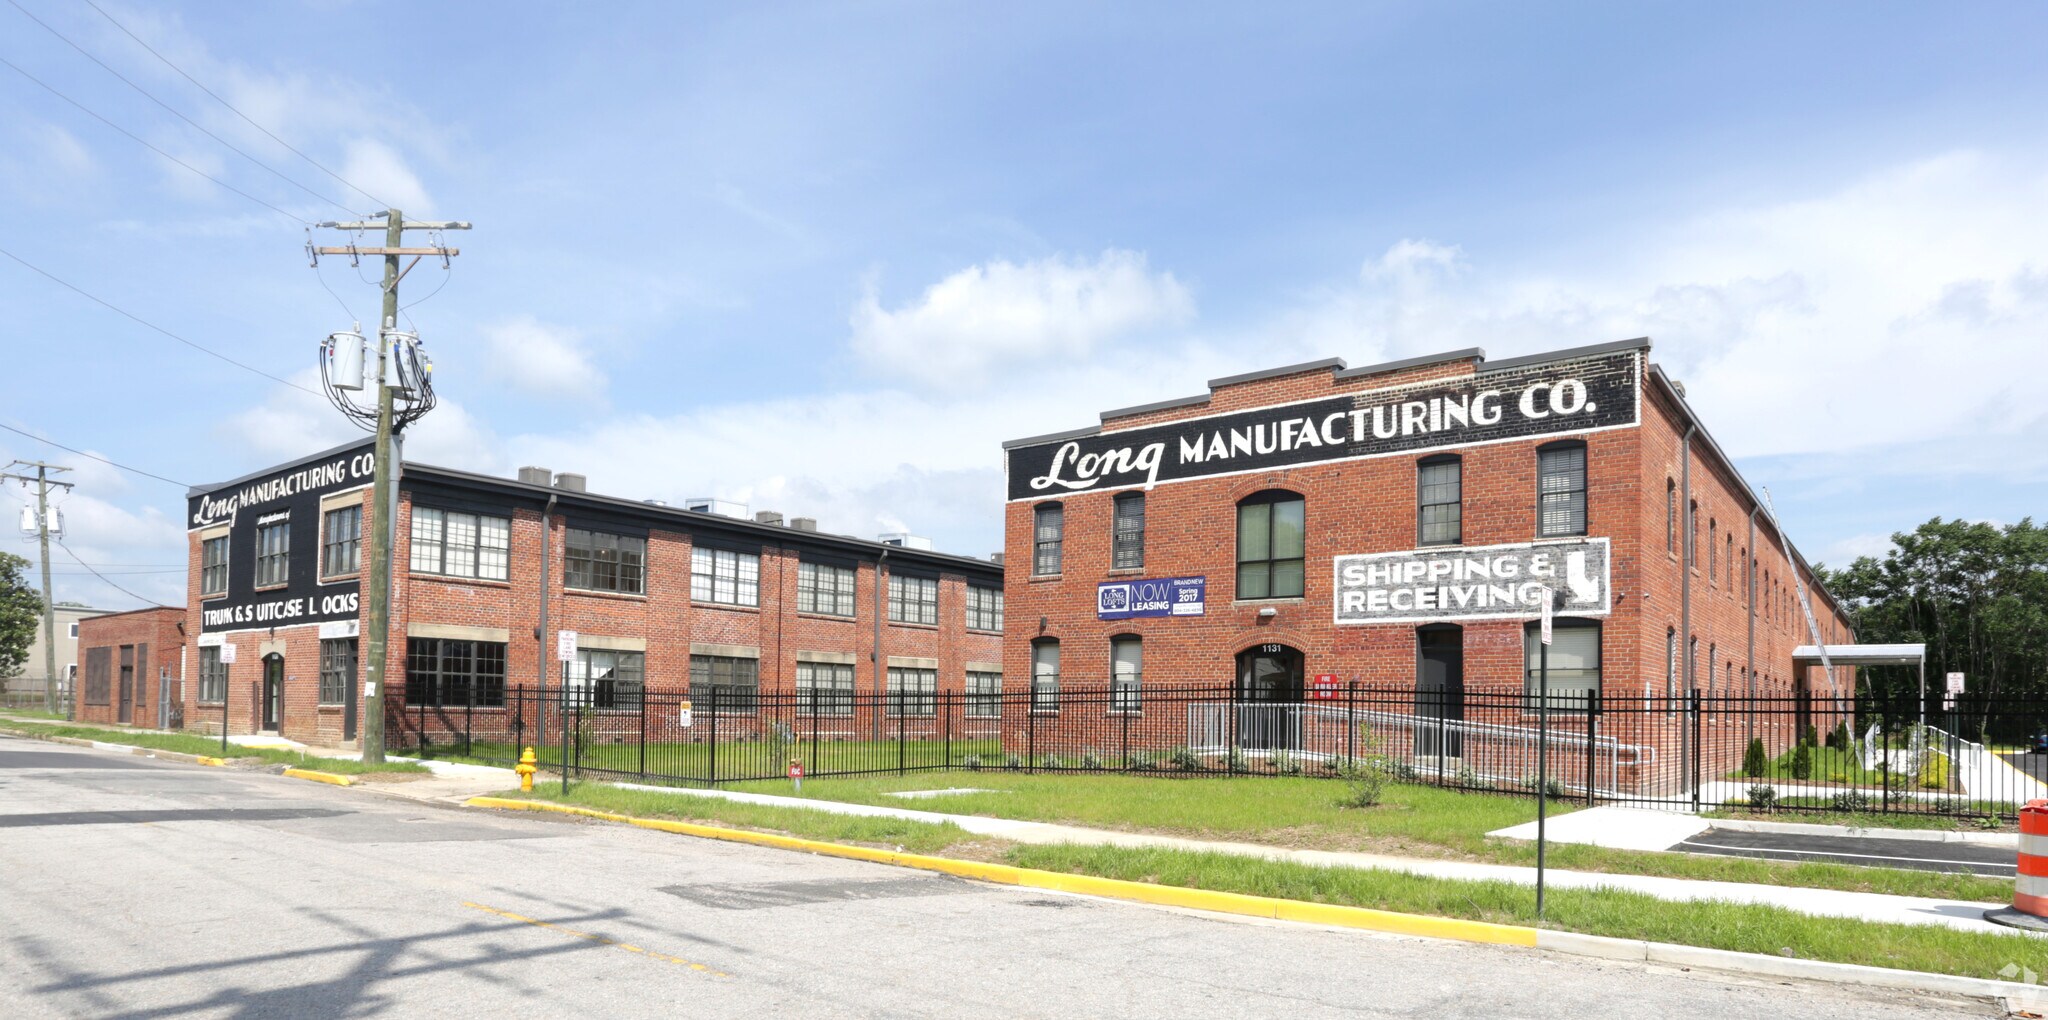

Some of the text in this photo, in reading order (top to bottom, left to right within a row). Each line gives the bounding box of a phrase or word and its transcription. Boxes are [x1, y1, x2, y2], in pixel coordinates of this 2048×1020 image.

[1030, 378, 1597, 490] Long MANUFACTURING CO.
[239, 460, 346, 509] MANUFACTURING
[1342, 553, 1556, 586] SHIPPING &
[1104, 591, 1124, 599] LONG
[1131, 583, 1170, 602] NOW
[1179, 588, 1198, 596] Spring
[1179, 594, 1198, 602] 2017
[1342, 582, 1542, 613] RECEIVING
[1103, 598, 1125, 606] LOFTS
[1131, 601, 1169, 611] LEASING
[235, 605, 244, 622] &
[1262, 644, 1282, 653] 1131
